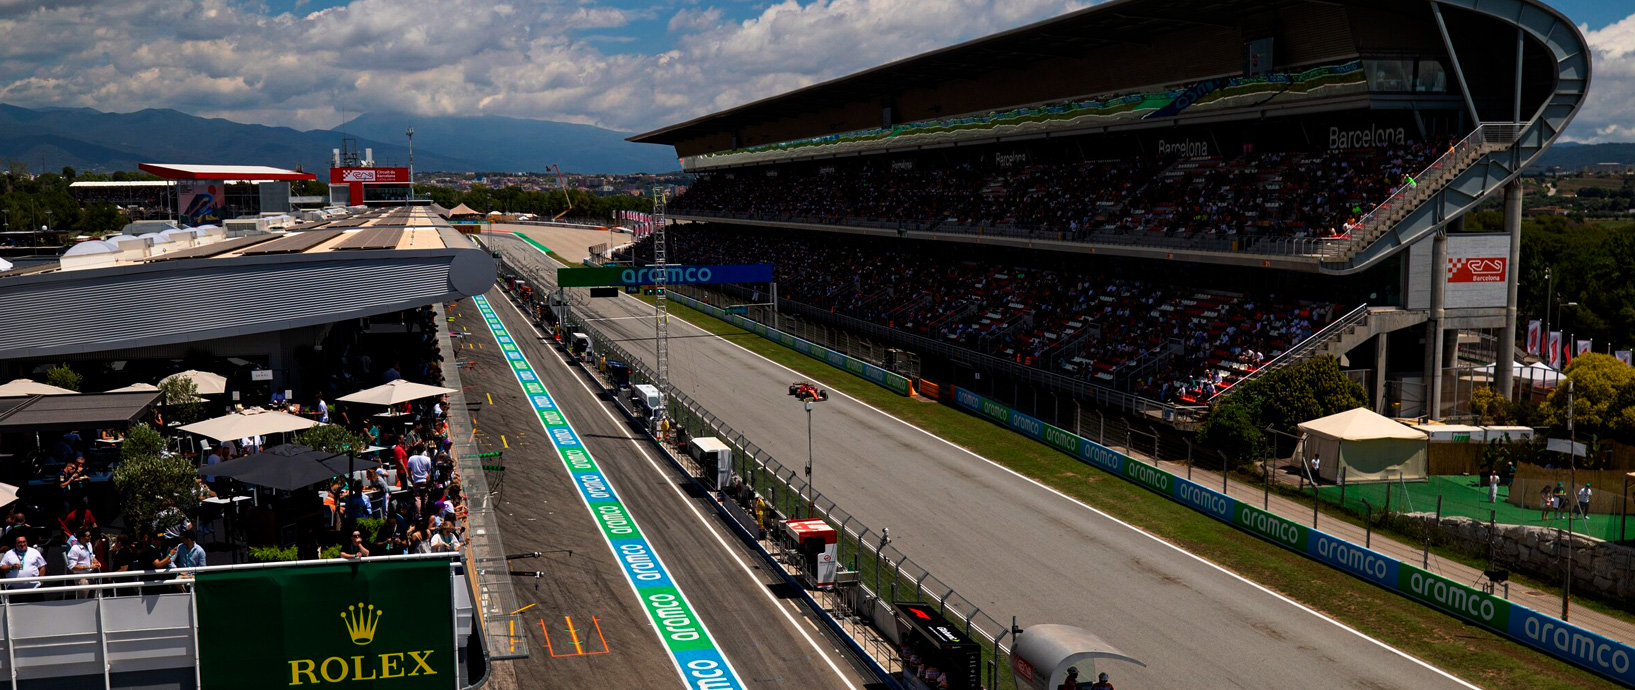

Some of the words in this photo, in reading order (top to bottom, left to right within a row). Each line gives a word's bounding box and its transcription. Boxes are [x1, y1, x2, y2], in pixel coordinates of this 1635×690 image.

[1158, 137, 1208, 157] Barcelona
[1329, 122, 1405, 149] Barcelona
[621, 267, 712, 283] aramco
[866, 366, 884, 381] aramco
[887, 374, 906, 390] aramco
[958, 391, 979, 409] aramco
[984, 402, 1007, 421] aramco
[1013, 414, 1039, 435] aramco
[1046, 427, 1076, 451] aramco
[1085, 443, 1118, 469] aramco
[580, 474, 611, 498] aramco
[1128, 462, 1168, 490] aramco
[1180, 482, 1227, 515] aramco
[598, 505, 633, 534] aramco
[1241, 507, 1299, 544] aramco
[620, 544, 662, 581] aramco
[1317, 537, 1387, 579] aramco
[1410, 572, 1495, 620] aramco
[648, 593, 700, 641] aramco
[1524, 616, 1630, 674] aramco
[288, 649, 437, 686] ROLEX
